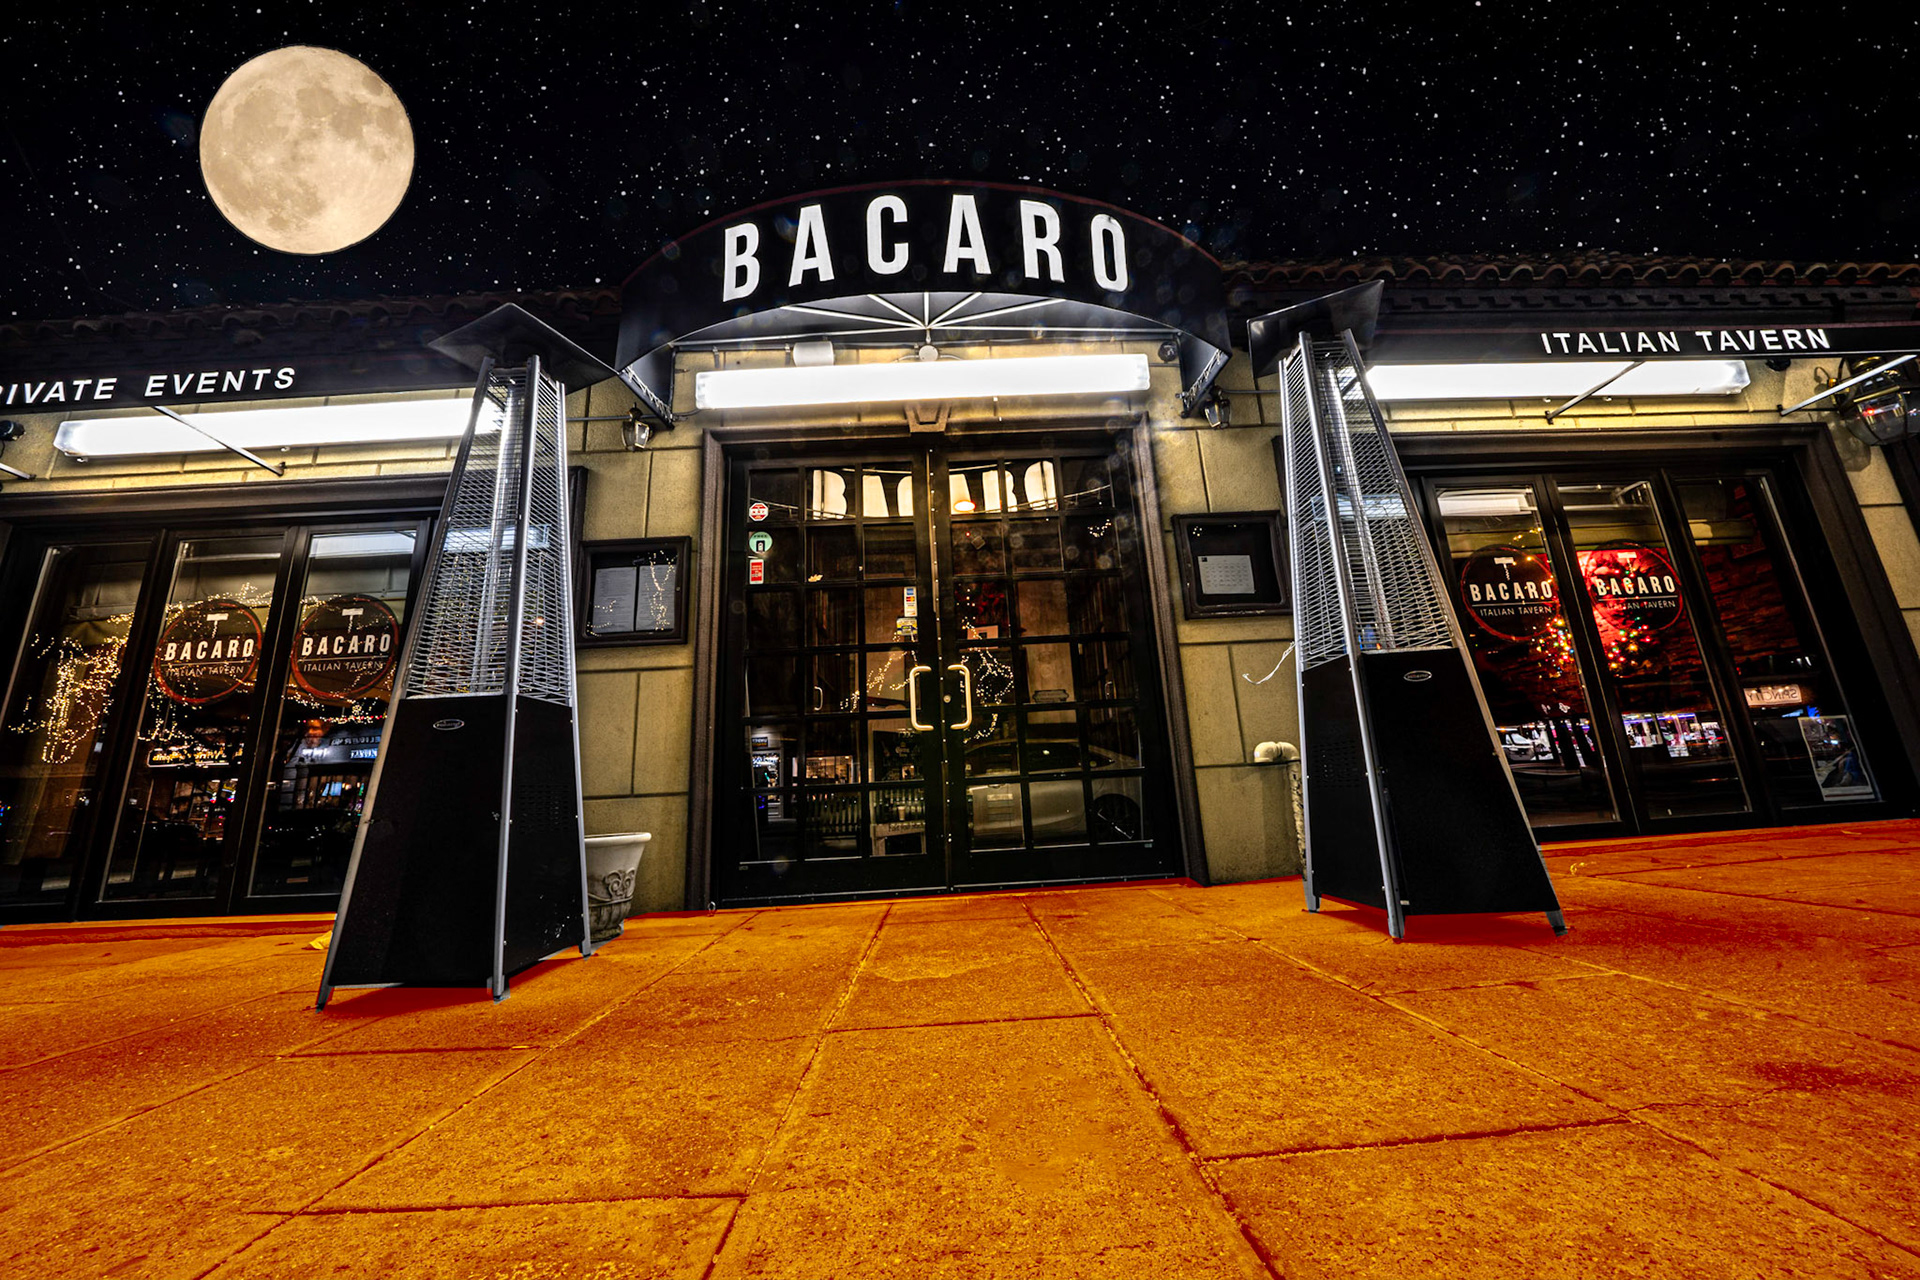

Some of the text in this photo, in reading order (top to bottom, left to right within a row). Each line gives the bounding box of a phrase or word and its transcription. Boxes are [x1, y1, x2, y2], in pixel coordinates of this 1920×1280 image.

[723, 195, 1128, 302] BACARO
[1541, 328, 1830, 354] ITALIAN TAVERN
[0, 367, 295, 404] IVATE EVENTS
[1470, 580, 1553, 602] BACARO
[1597, 575, 1676, 597] BACARO
[1480, 605, 1552, 617] ITALIAN TAVERN
[1642, 600, 1676, 609] TAVERN
[164, 638, 255, 662] BACARO
[301, 633, 391, 656] BACARO
[166, 665, 245, 678] ITALIAN TAVERN
[303, 660, 384, 672] ITALIAN TAVERN
